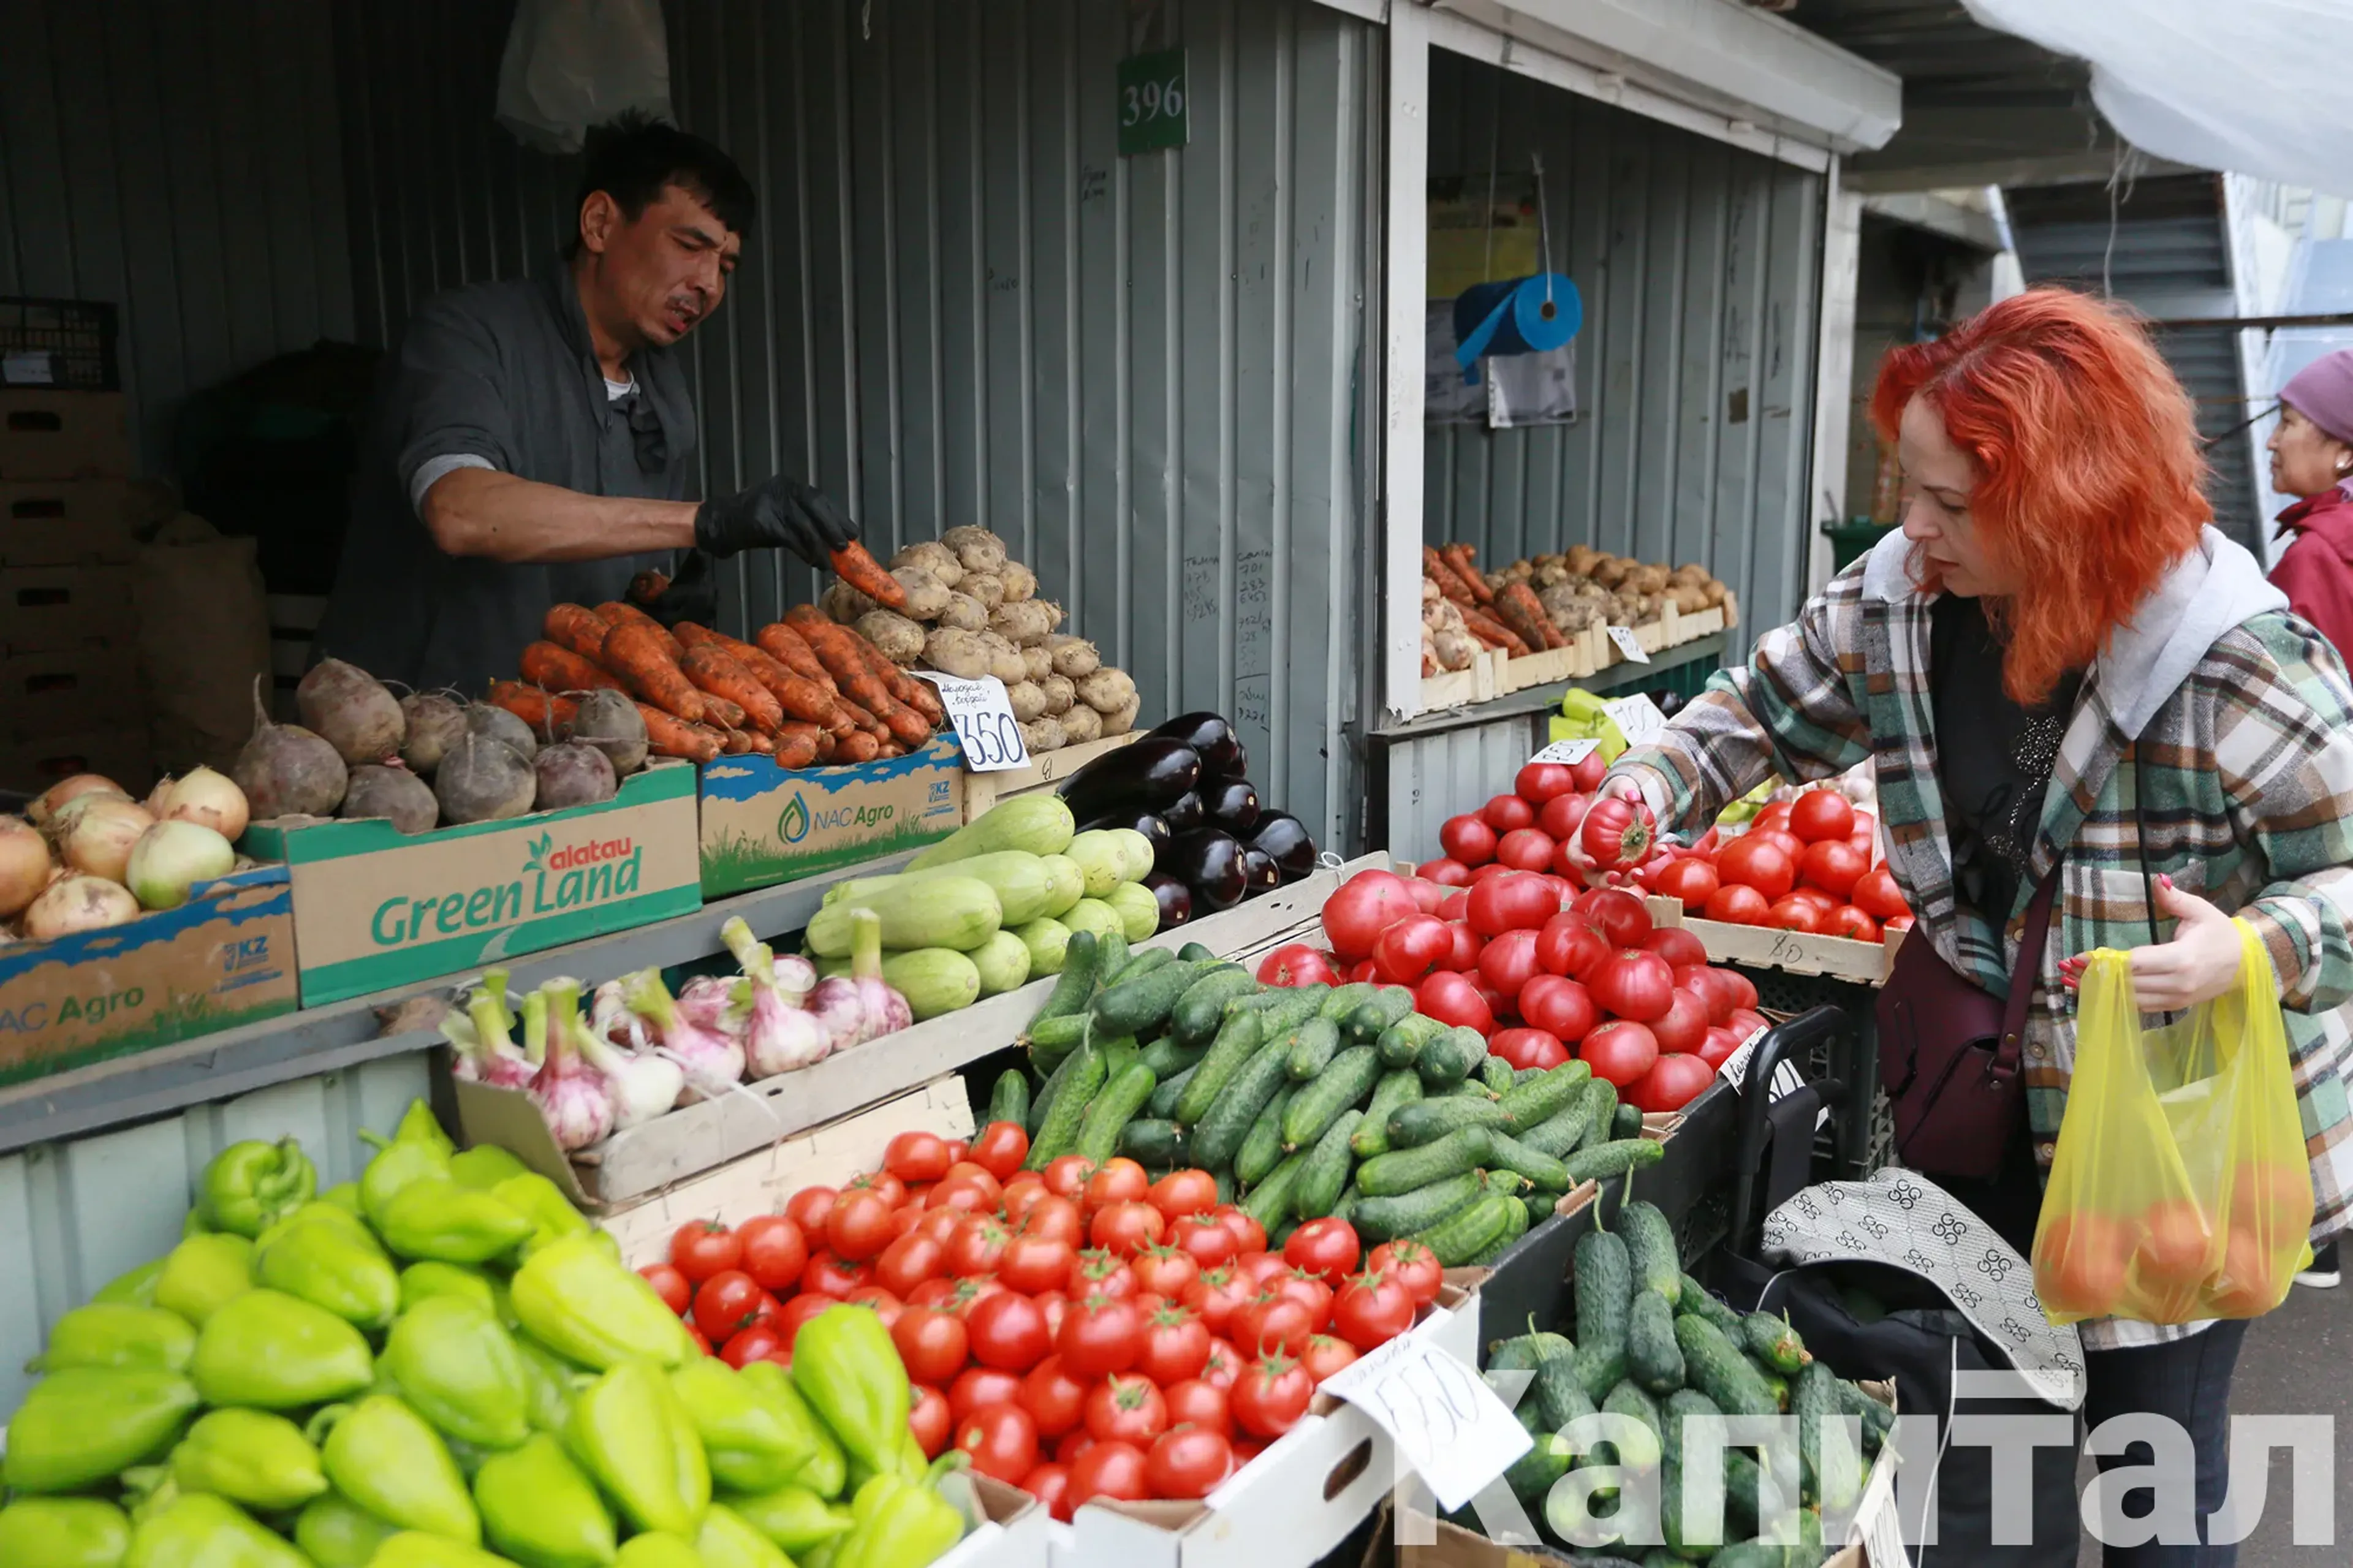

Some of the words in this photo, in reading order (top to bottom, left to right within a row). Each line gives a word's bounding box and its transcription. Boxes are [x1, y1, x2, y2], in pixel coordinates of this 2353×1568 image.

[1123, 75, 1183, 126] 396
[953, 711, 1023, 765] 350
[814, 807, 852, 831] NAC
[853, 805, 893, 827] Agro
[549, 837, 632, 870] alatau
[371, 879, 523, 945] Green
[533, 846, 642, 914] Land
[56, 987, 145, 1025] Agro
